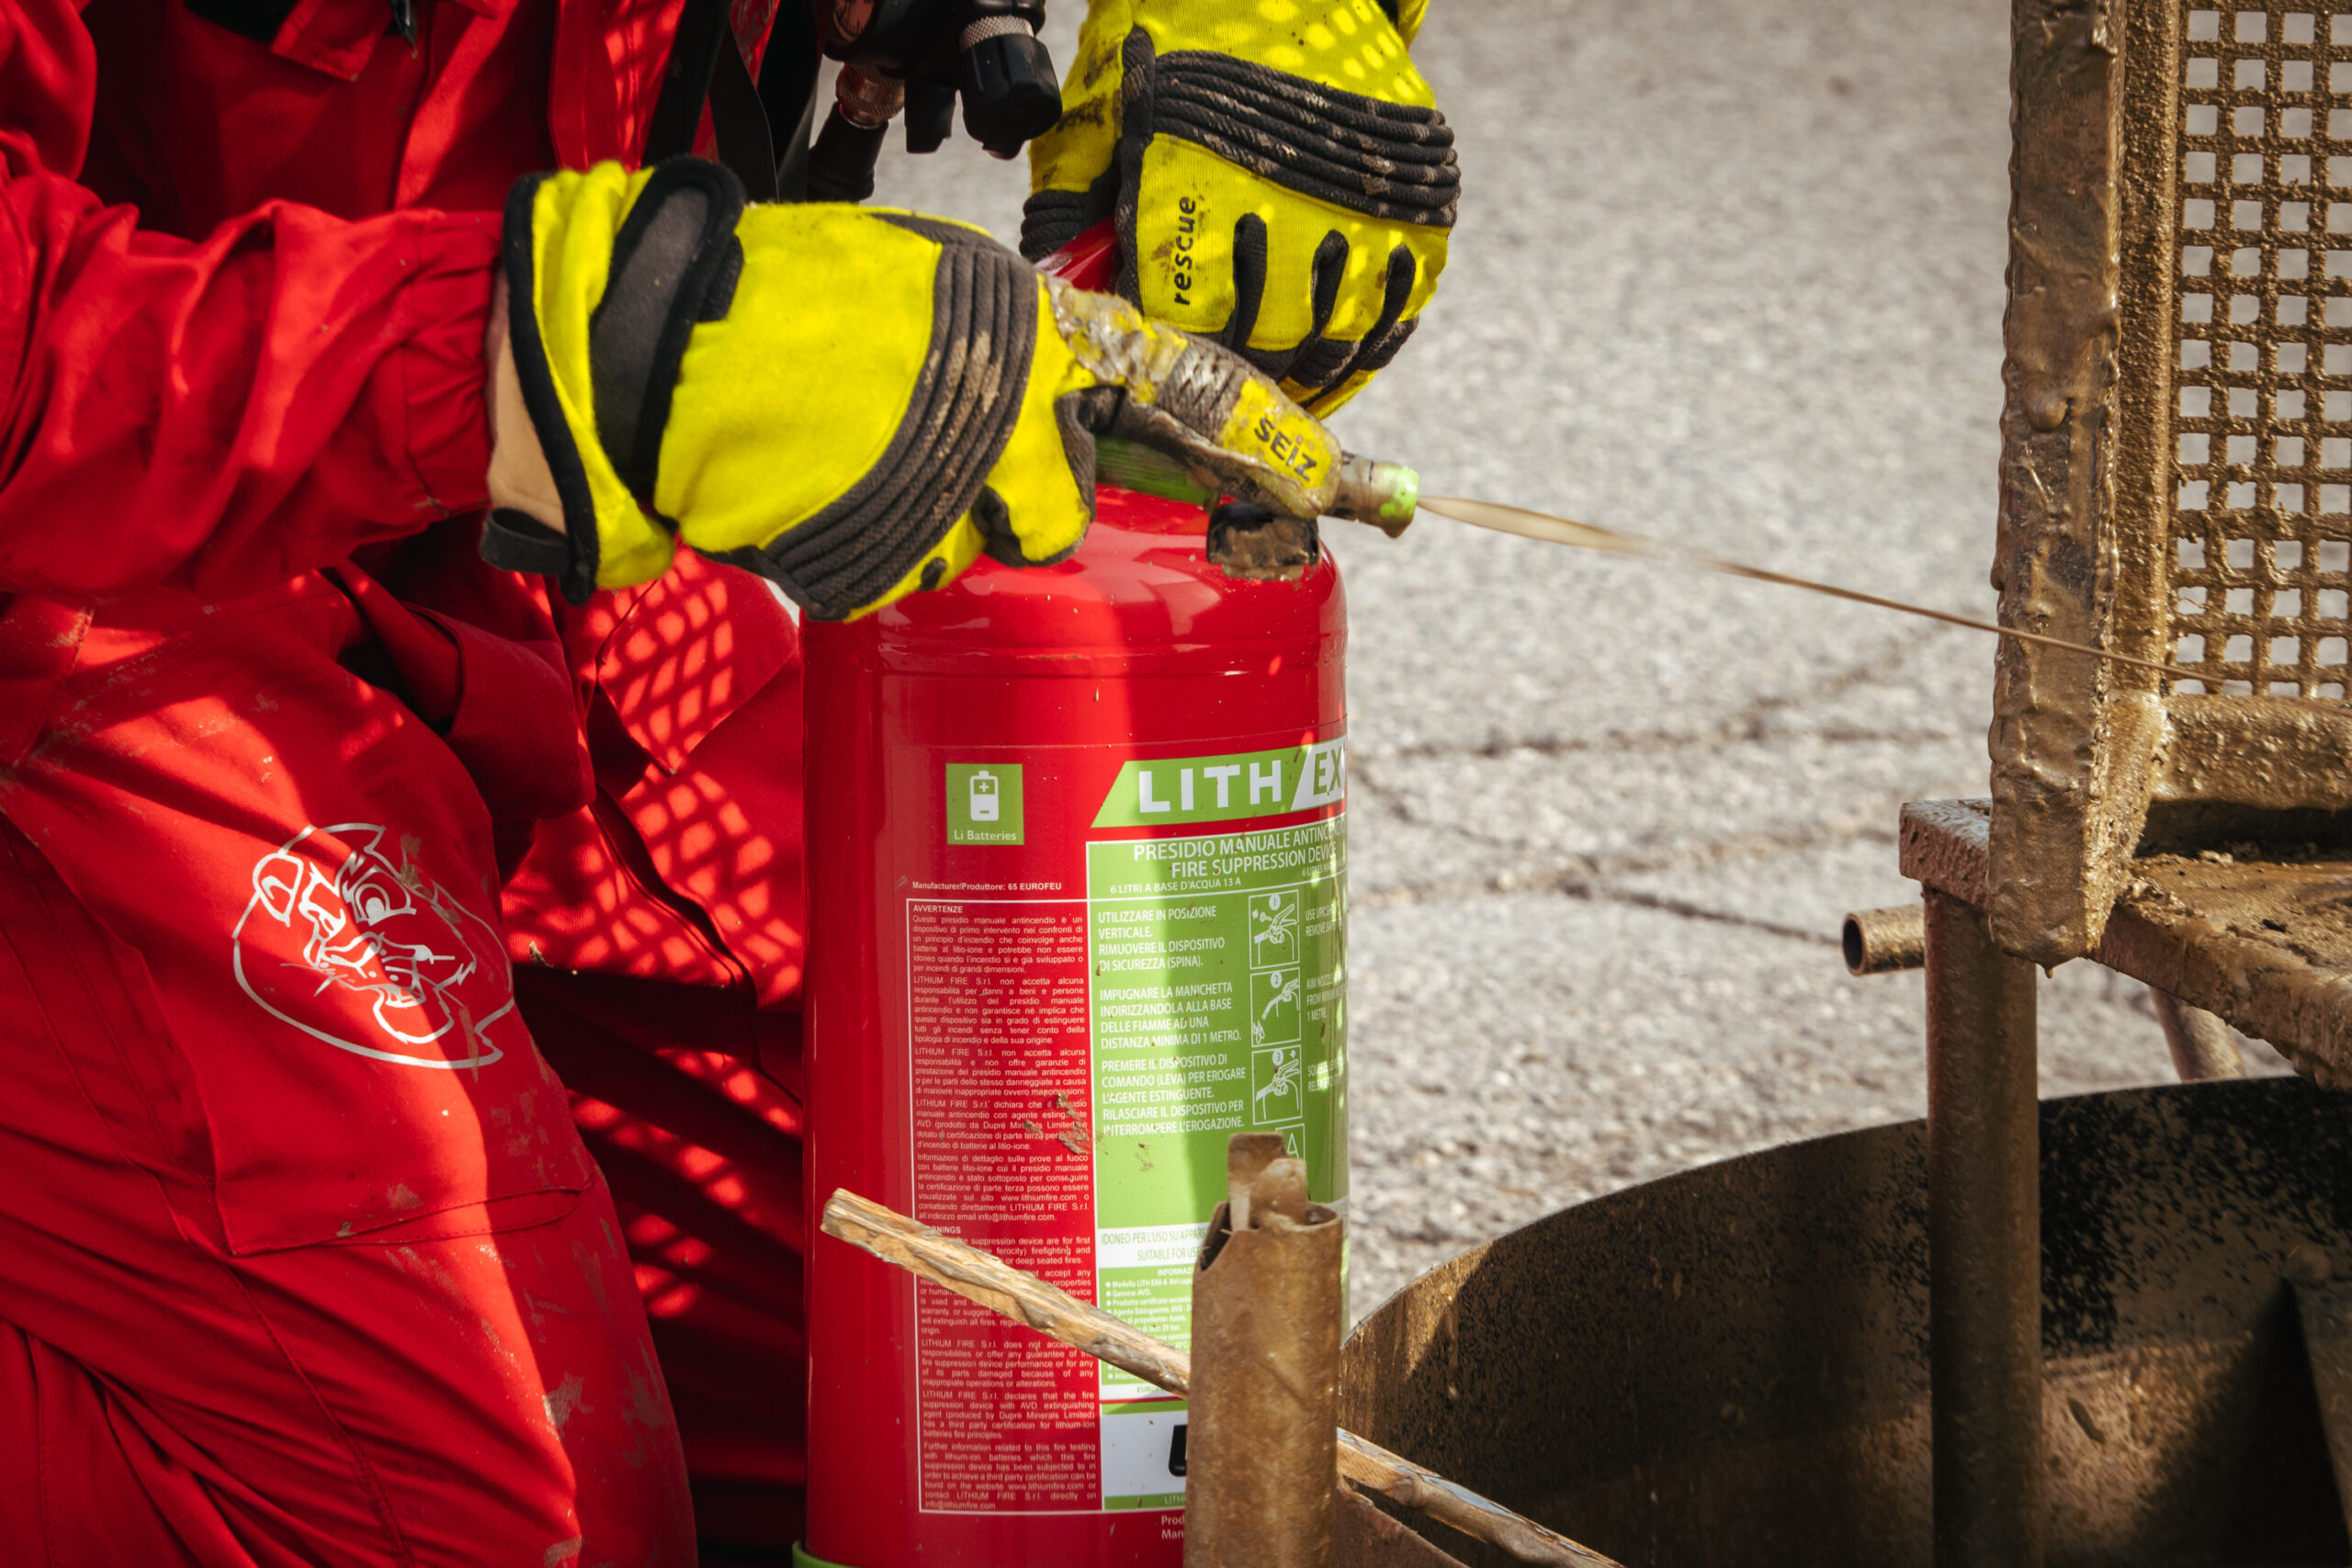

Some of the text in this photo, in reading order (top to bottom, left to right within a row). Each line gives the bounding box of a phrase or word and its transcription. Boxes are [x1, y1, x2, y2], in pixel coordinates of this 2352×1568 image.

[1174, 196, 1195, 306] rescue
[1139, 760, 1282, 814] LITH
[954, 829, 1016, 840] Li Batteries
[1134, 840, 1215, 862] PRESIDIO
[1219, 831, 1290, 855] MANUALE
[1171, 860, 1207, 878] FIRE
[1213, 849, 1306, 875] SUPPRESSION
[912, 881, 1005, 891] Manufacturer/Produttore:
[1110, 877, 1241, 894] 6 LITRI A BASE D'ACQUA 13 A
[912, 905, 963, 913] AVVERTENZE
[1098, 906, 1216, 923] UTILIZZARE IN POSIZIONE
[941, 916, 968, 924] presidio
[1012, 916, 1056, 924] antincendio
[1099, 937, 1226, 956] RIMUOVERE IL DISPOSITIVO
[1099, 954, 1204, 972] DI SICUREZZA (SPINA).
[1100, 982, 1232, 1001] IMPUGNARE LA MANICHETTA
[1100, 998, 1232, 1018] INDIRIZZANDOLA ALLA BASE
[1101, 1016, 1209, 1033] DELLE FIAMME AD UNA
[1101, 1029, 1241, 1050] DISTANZA MINIMA DI 1 METRO.
[1102, 1054, 1227, 1072] PREMERE IL DISPOSITIVO DI
[915, 1067, 955, 1077] prestazione
[972, 1068, 1001, 1077] presidio
[1102, 1066, 1246, 1089] COMANDO (LEVA) PER EROGARE
[1102, 1087, 1215, 1104] L'AGENTE ESTINGUENTE.
[1102, 1100, 1244, 1121] RILASCIARE IL DISPOSITIVO PER
[1102, 1116, 1245, 1137] INTERROMPERE L'EROGAZIONE.
[1021, 1165, 1050, 1173] presidio
[961, 1203, 1006, 1212] direttamente
[971, 1237, 1015, 1247] suppression
[1076, 1236, 1091, 1245] first
[1102, 1232, 1131, 1245] IDONEO
[1133, 1232, 1146, 1243] PER
[1148, 1231, 1168, 1243] L'USO
[1170, 1230, 1179, 1241] SU
[1137, 1248, 1170, 1261] SUITABLE
[1172, 1247, 1186, 1258] FOR
[922, 1391, 953, 1399] LITHIUM
[957, 1392, 977, 1400] FIRE
[1004, 1392, 1037, 1400] declares
[1043, 1392, 1057, 1400] that
[1063, 1392, 1077, 1400] the
[1161, 1515, 1184, 1525] Prod
[1161, 1529, 1183, 1540] Man
